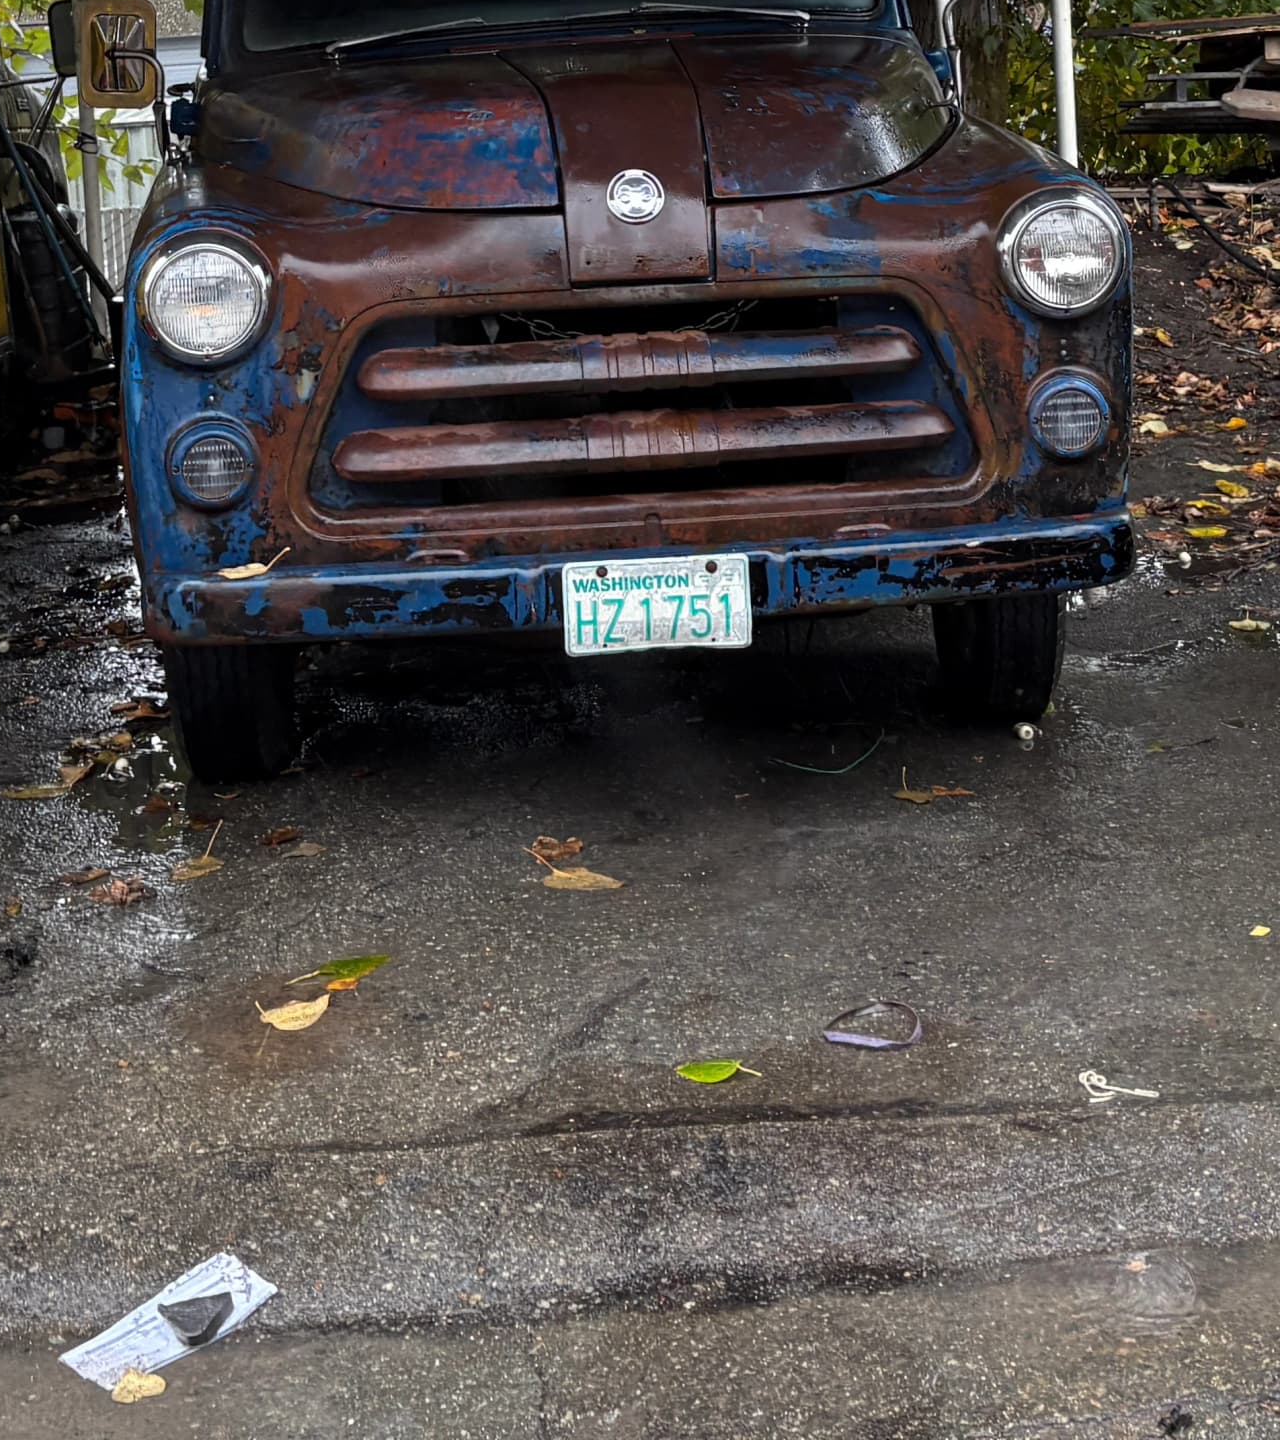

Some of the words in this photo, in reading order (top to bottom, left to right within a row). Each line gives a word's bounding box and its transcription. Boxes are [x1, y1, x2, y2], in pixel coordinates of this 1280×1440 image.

[573, 574, 689, 593] WASHINGTON
[576, 597, 625, 645] HZ
[640, 593, 732, 641] 1751
